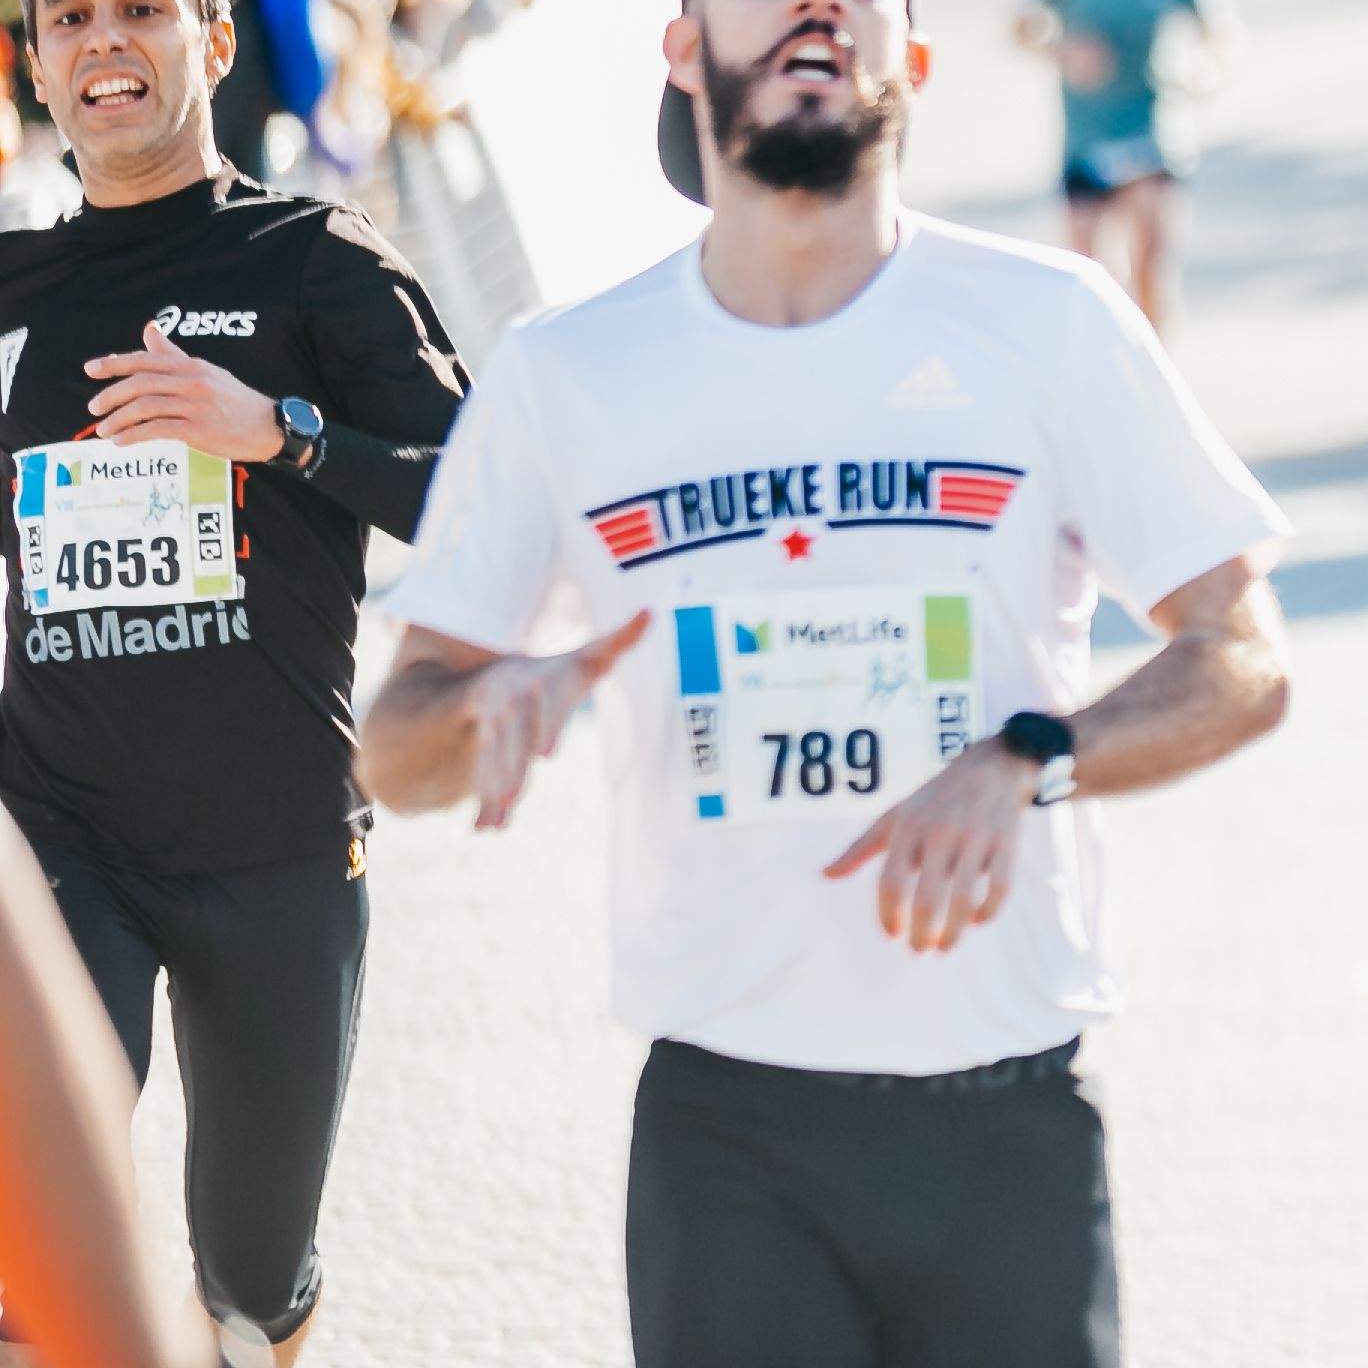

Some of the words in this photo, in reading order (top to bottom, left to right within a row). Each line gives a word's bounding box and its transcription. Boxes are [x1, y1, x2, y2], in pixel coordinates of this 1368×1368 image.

[90, 458, 178, 480] MetLife
[650, 464, 823, 541] TRUEKE
[839, 460, 930, 512] RUN
[56, 536, 180, 591] 4653
[25, 617, 73, 663] de
[763, 728, 880, 797] 789
